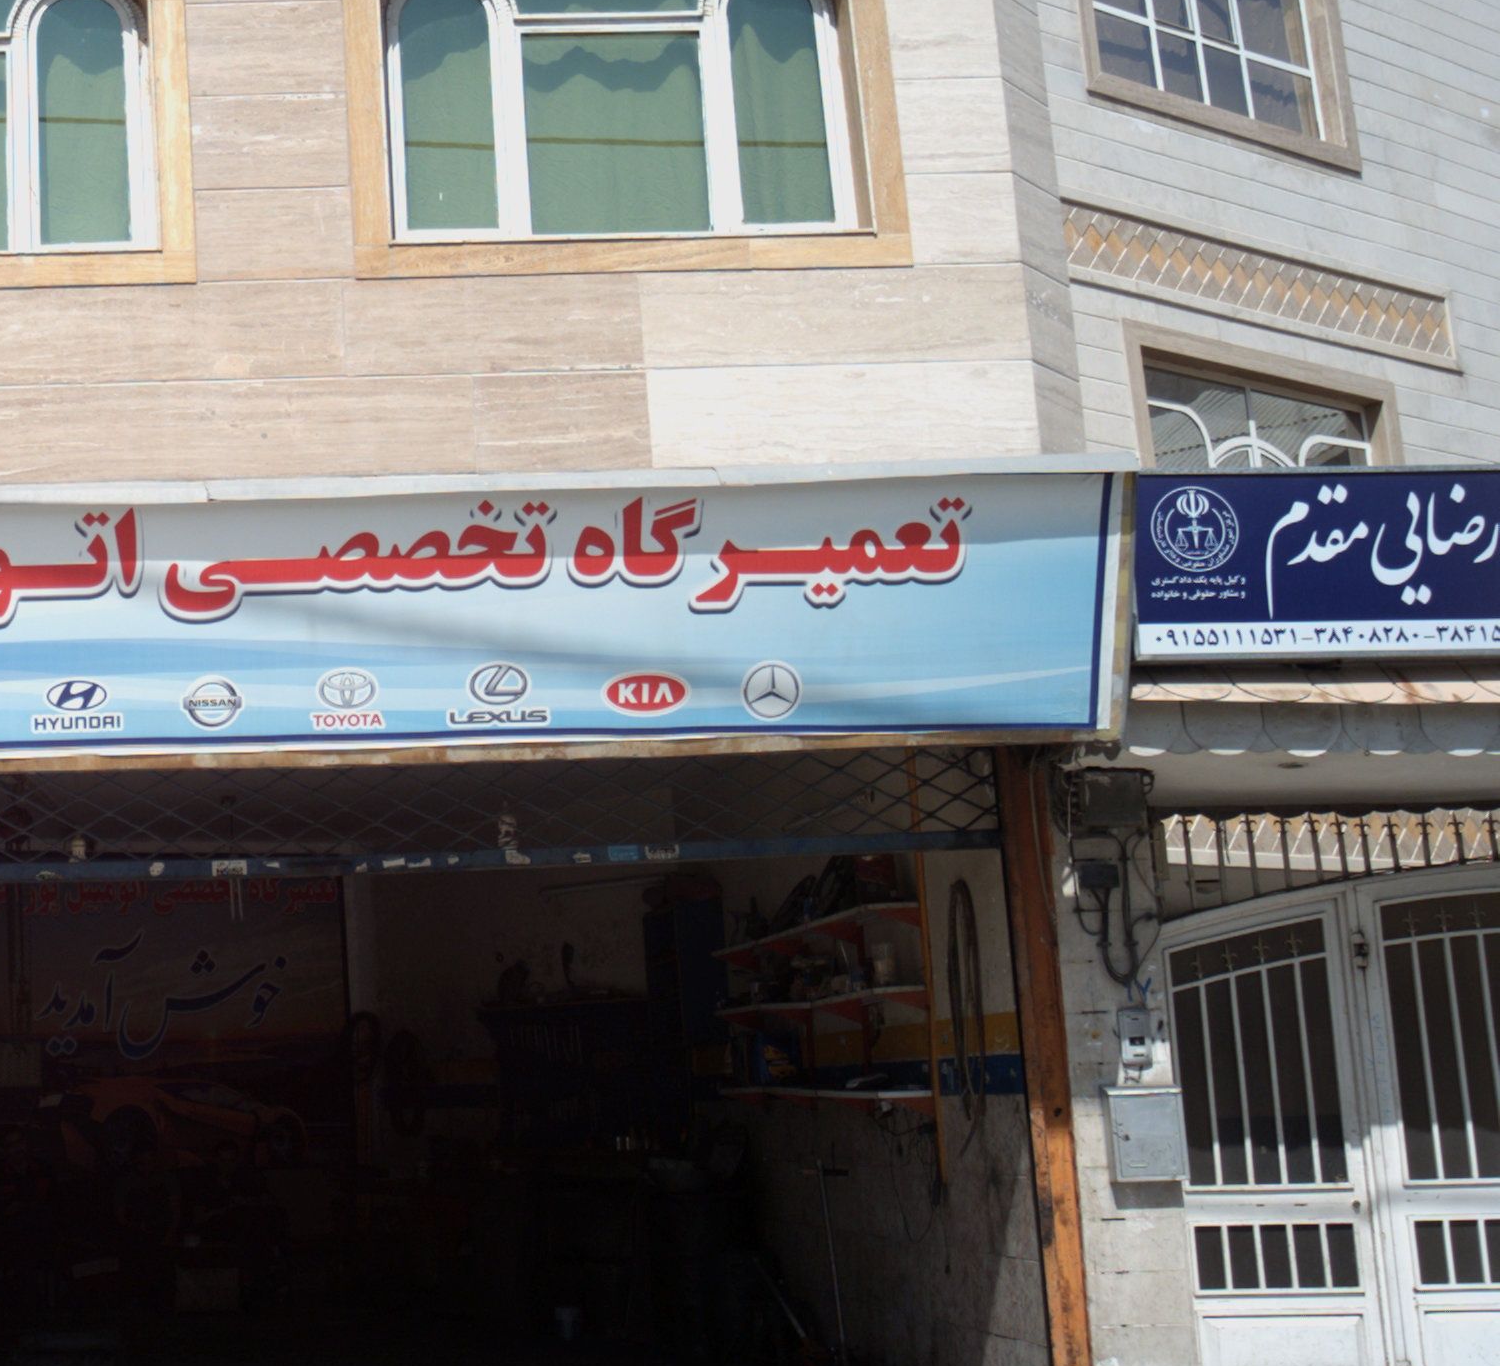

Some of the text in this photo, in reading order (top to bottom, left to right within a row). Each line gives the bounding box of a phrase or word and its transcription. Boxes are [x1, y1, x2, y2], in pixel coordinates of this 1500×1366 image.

[163, 499, 548, 613] تخصصی
[1265, 483, 1369, 619] مقدم
[618, 683, 674, 704] KIA
[188, 698, 237, 708] NISSAN
[34, 716, 121, 731] HYUNDAI
[313, 713, 382, 728] TOYOTA
[450, 710, 547, 725] LEXUS
[33, 926, 288, 1061] خوش آمدید
